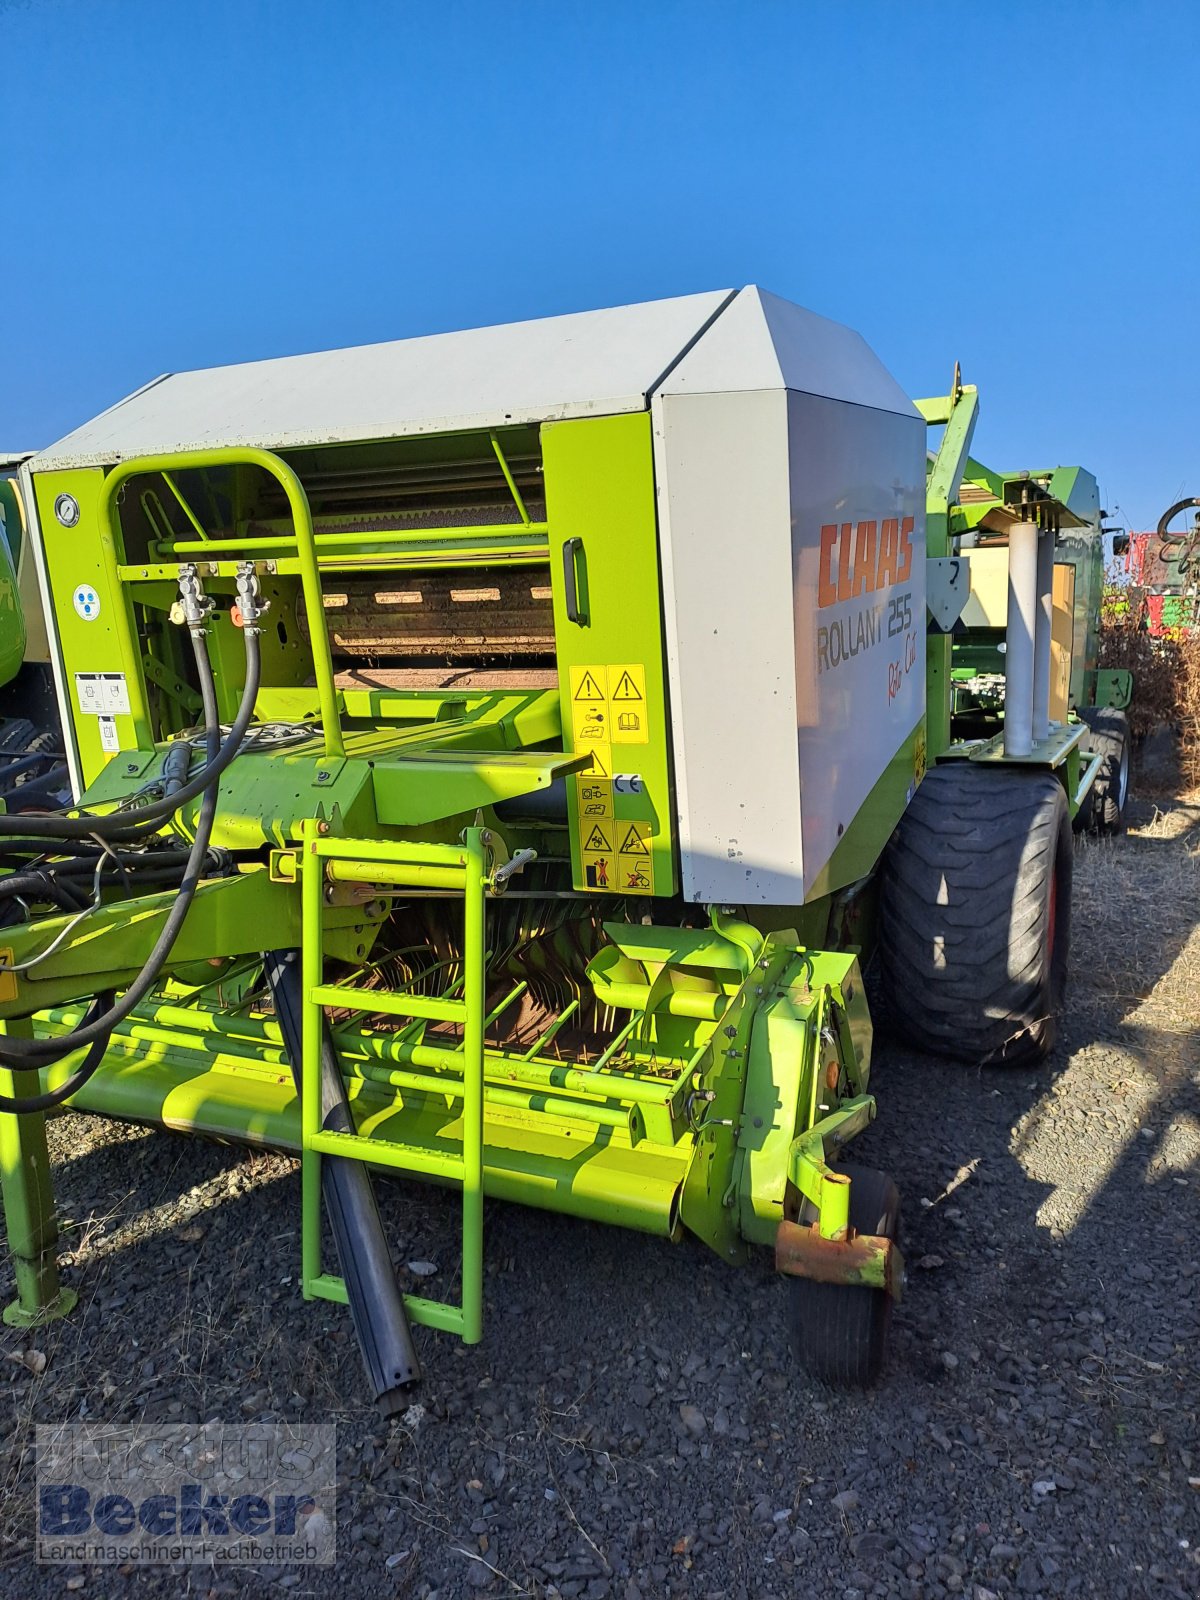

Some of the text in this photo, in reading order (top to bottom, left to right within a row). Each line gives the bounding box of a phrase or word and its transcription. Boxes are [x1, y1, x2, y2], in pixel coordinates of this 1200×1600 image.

[819, 517, 914, 608] CLAAS
[818, 593, 913, 674] ROLLANT 255
[888, 630, 918, 707] Roto Cut
[615, 775, 639, 792] CE
